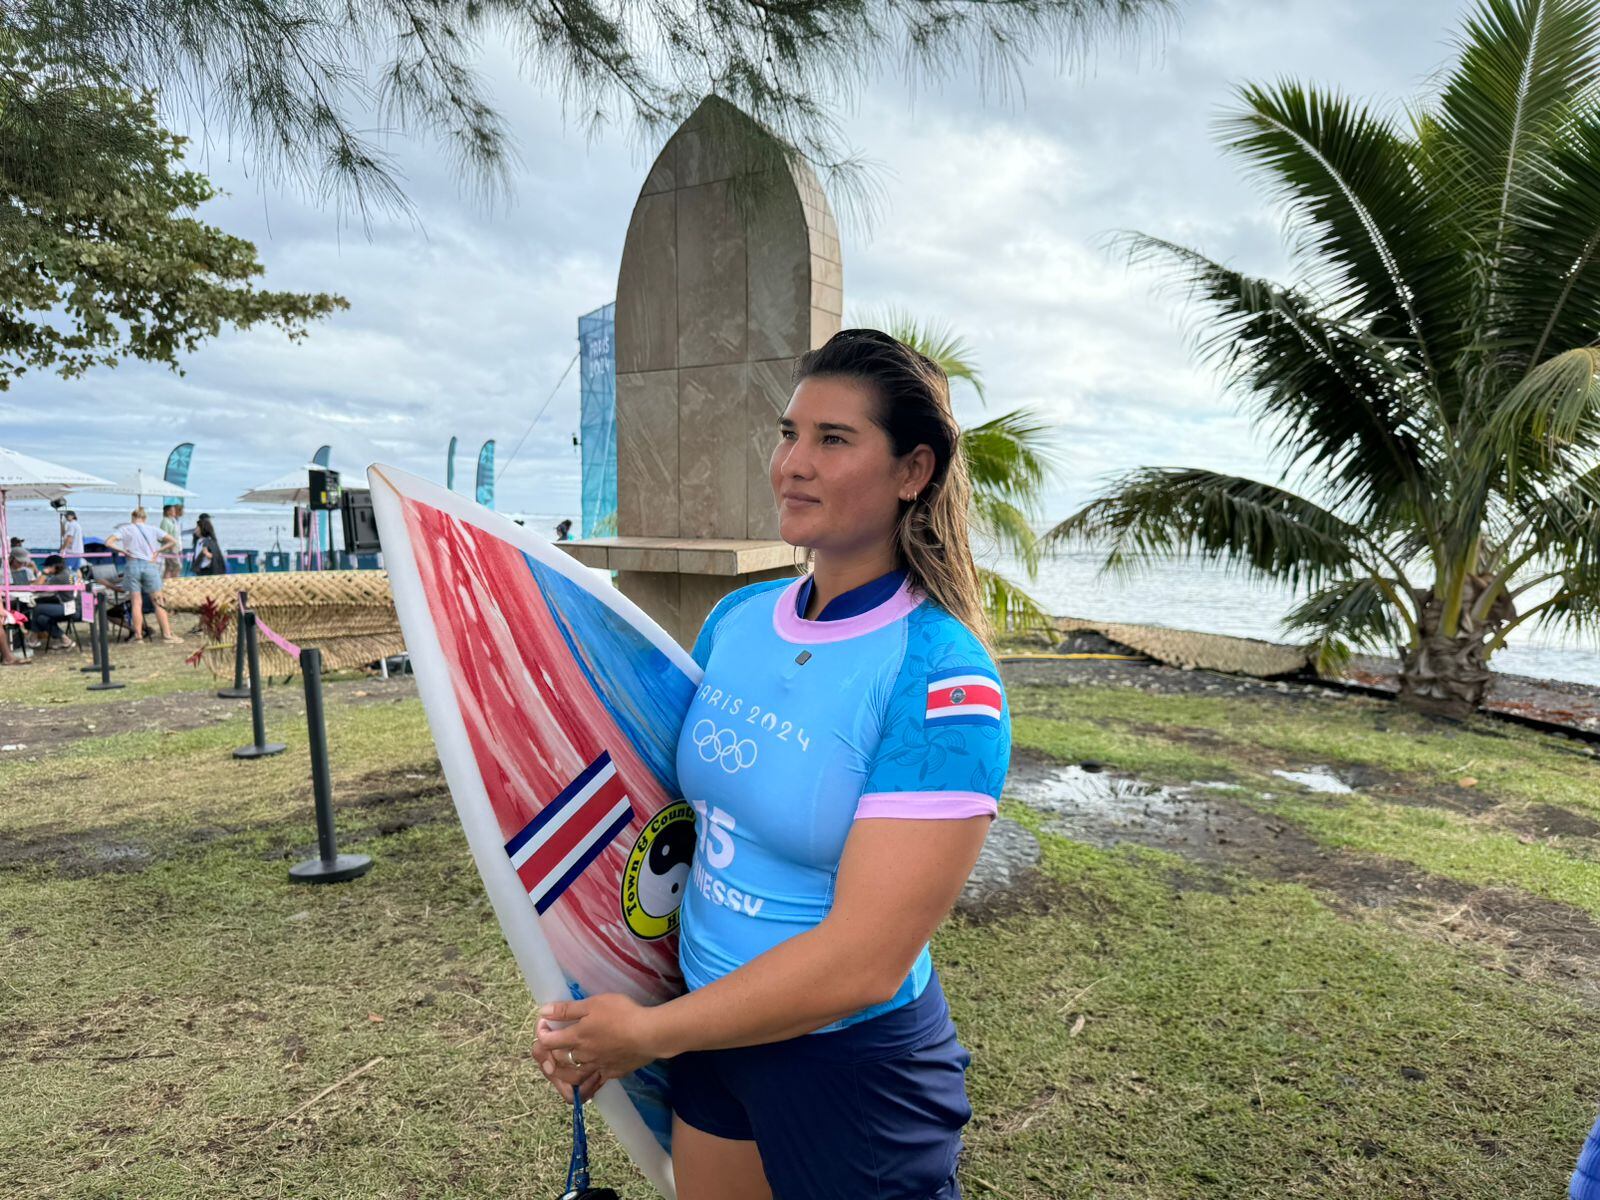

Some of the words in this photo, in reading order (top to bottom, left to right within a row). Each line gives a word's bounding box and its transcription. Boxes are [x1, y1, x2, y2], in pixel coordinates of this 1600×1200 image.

[746, 705, 810, 752] 2024
[626, 860, 640, 917] Town
[637, 835, 648, 853] &
[651, 805, 695, 834] Count
[692, 799, 736, 870] 15
